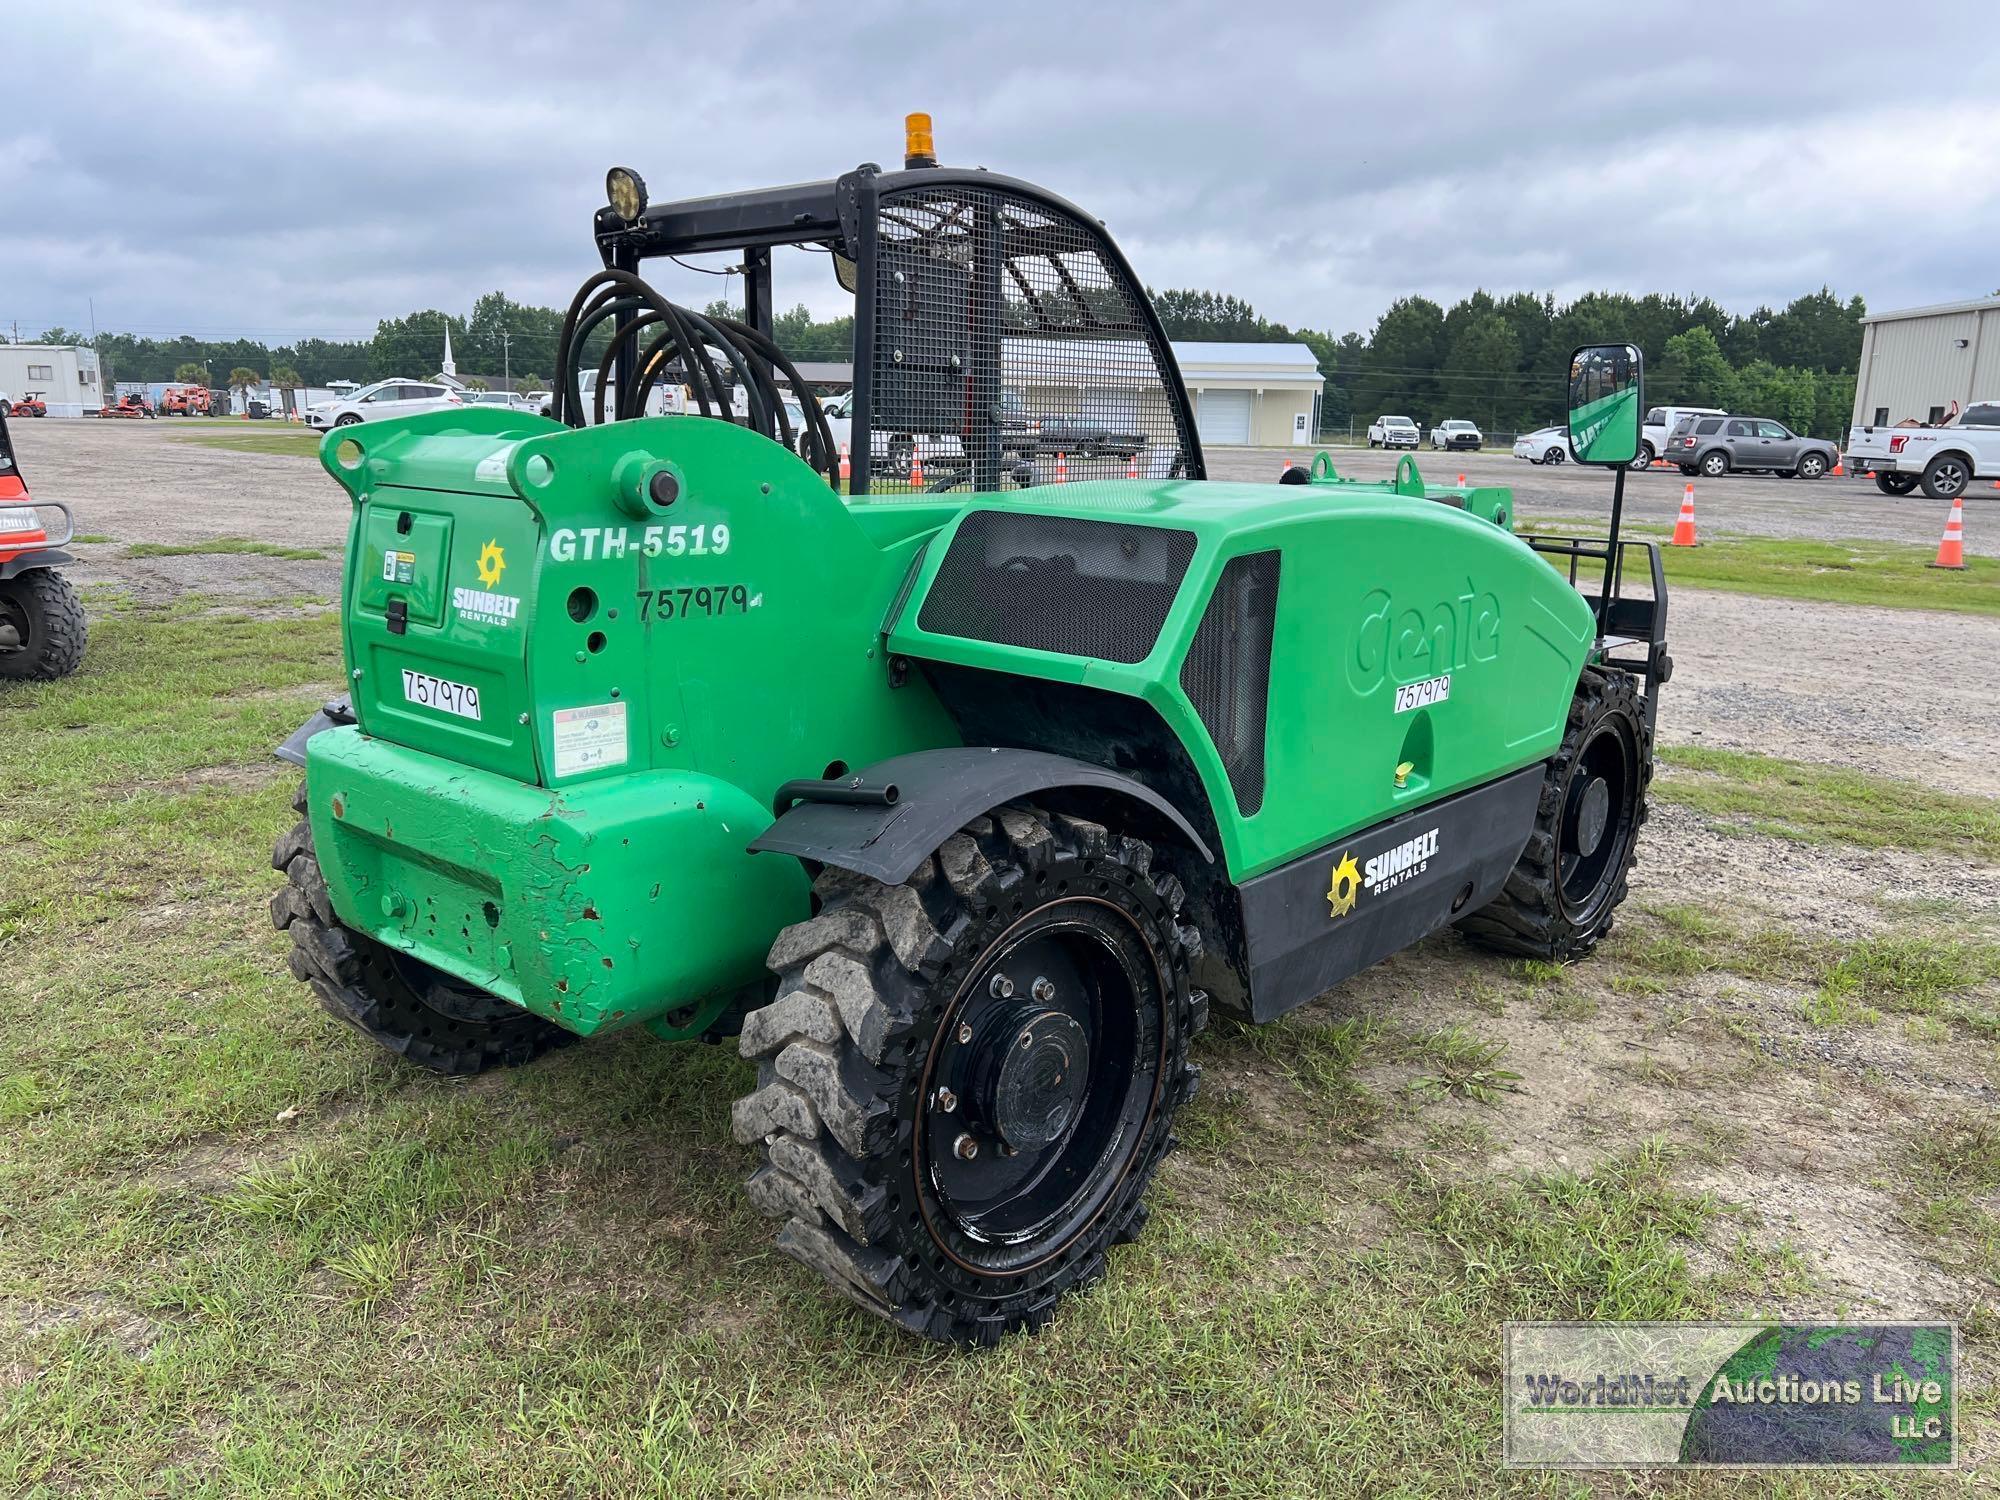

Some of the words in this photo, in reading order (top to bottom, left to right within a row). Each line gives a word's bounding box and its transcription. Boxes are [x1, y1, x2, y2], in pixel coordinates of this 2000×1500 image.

[550, 524, 730, 562] GTH-5519
[453, 587, 520, 619] SUNBELT
[460, 610, 508, 627] RENTALS
[636, 584, 748, 622] 757979
[1346, 576, 1500, 696] Genie
[404, 671, 480, 718] 757979
[1398, 676, 1449, 711] 757979
[1364, 828, 1439, 888] SUNBELT
[1374, 861, 1427, 896] RENTALS
